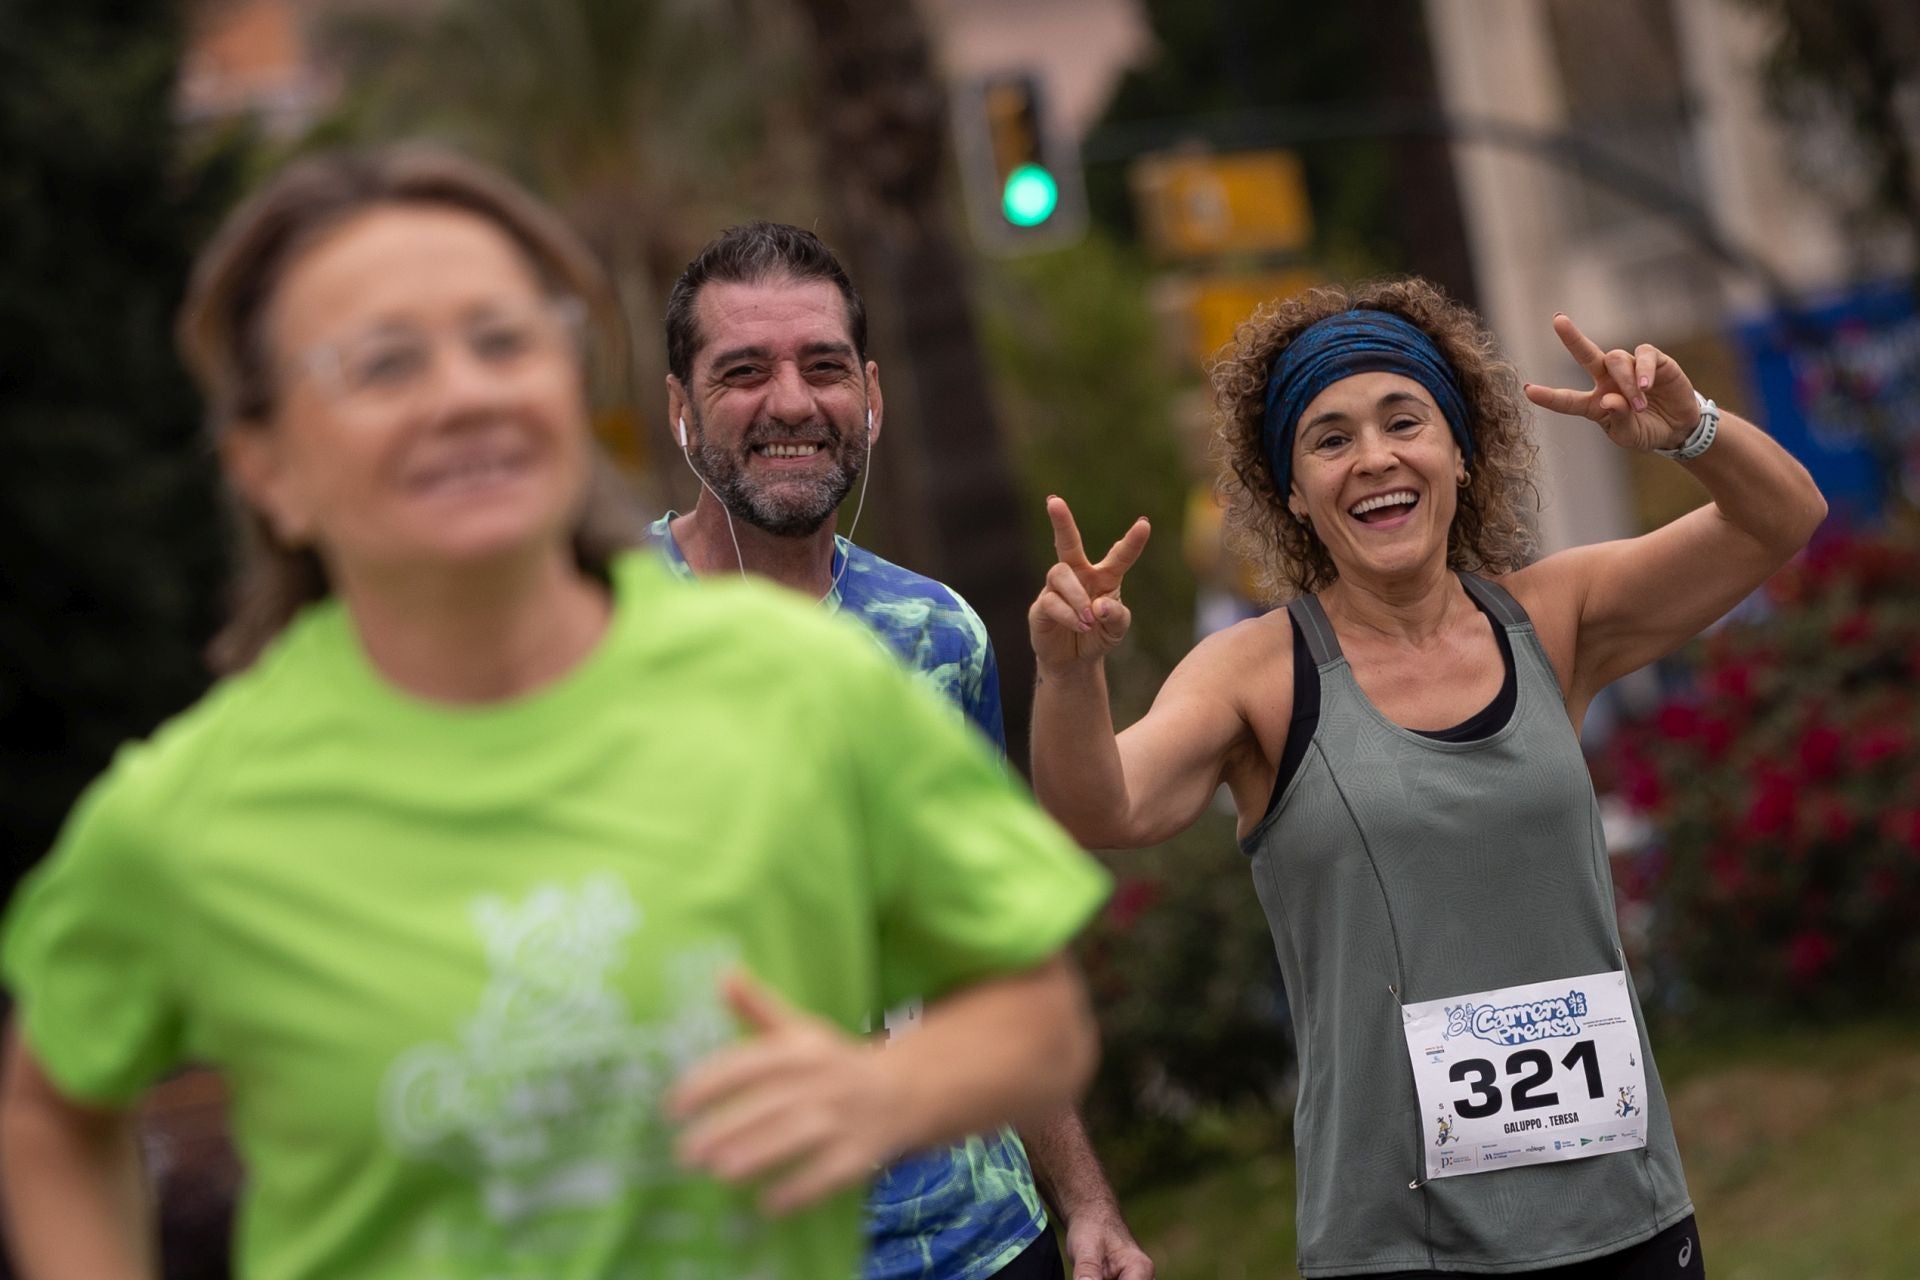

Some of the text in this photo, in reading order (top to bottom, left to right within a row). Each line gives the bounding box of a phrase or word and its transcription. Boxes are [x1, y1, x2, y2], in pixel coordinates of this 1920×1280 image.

[1476, 999, 1569, 1032] Carrera
[1569, 992, 1584, 1005] de
[1570, 1002, 1586, 1015] la
[1498, 1016, 1578, 1044] Prensa
[1449, 1039, 1605, 1119] 321
[1503, 1118, 1542, 1134] GALUPPO
[1549, 1112, 1580, 1127] TERESA
